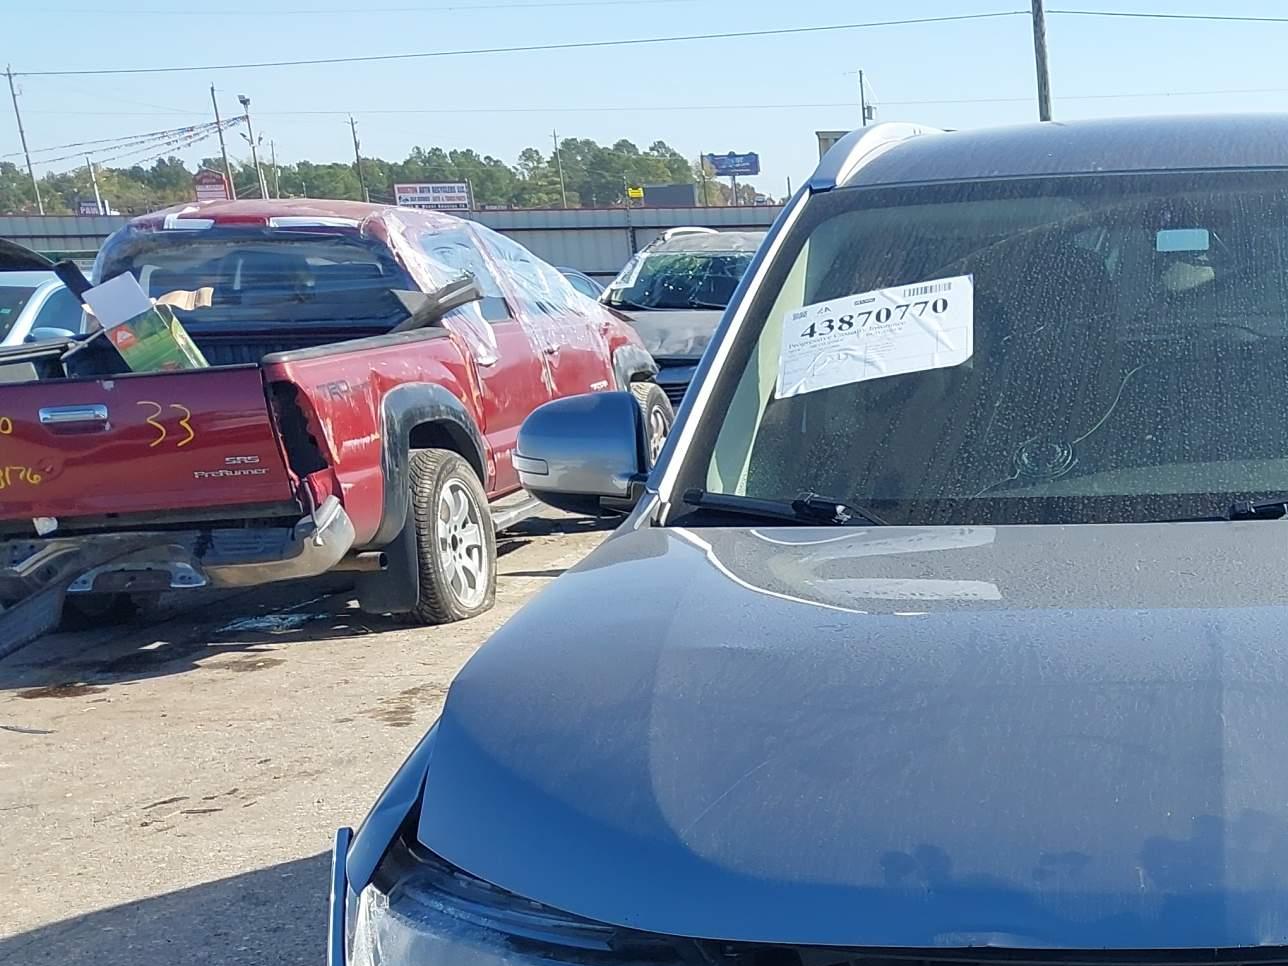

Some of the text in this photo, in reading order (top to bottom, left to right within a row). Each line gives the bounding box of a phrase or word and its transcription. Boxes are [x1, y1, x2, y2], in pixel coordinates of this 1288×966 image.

[800, 297, 949, 338] 43870770
[136, 401, 195, 447] 33
[194, 467, 269, 479] PreRunner
